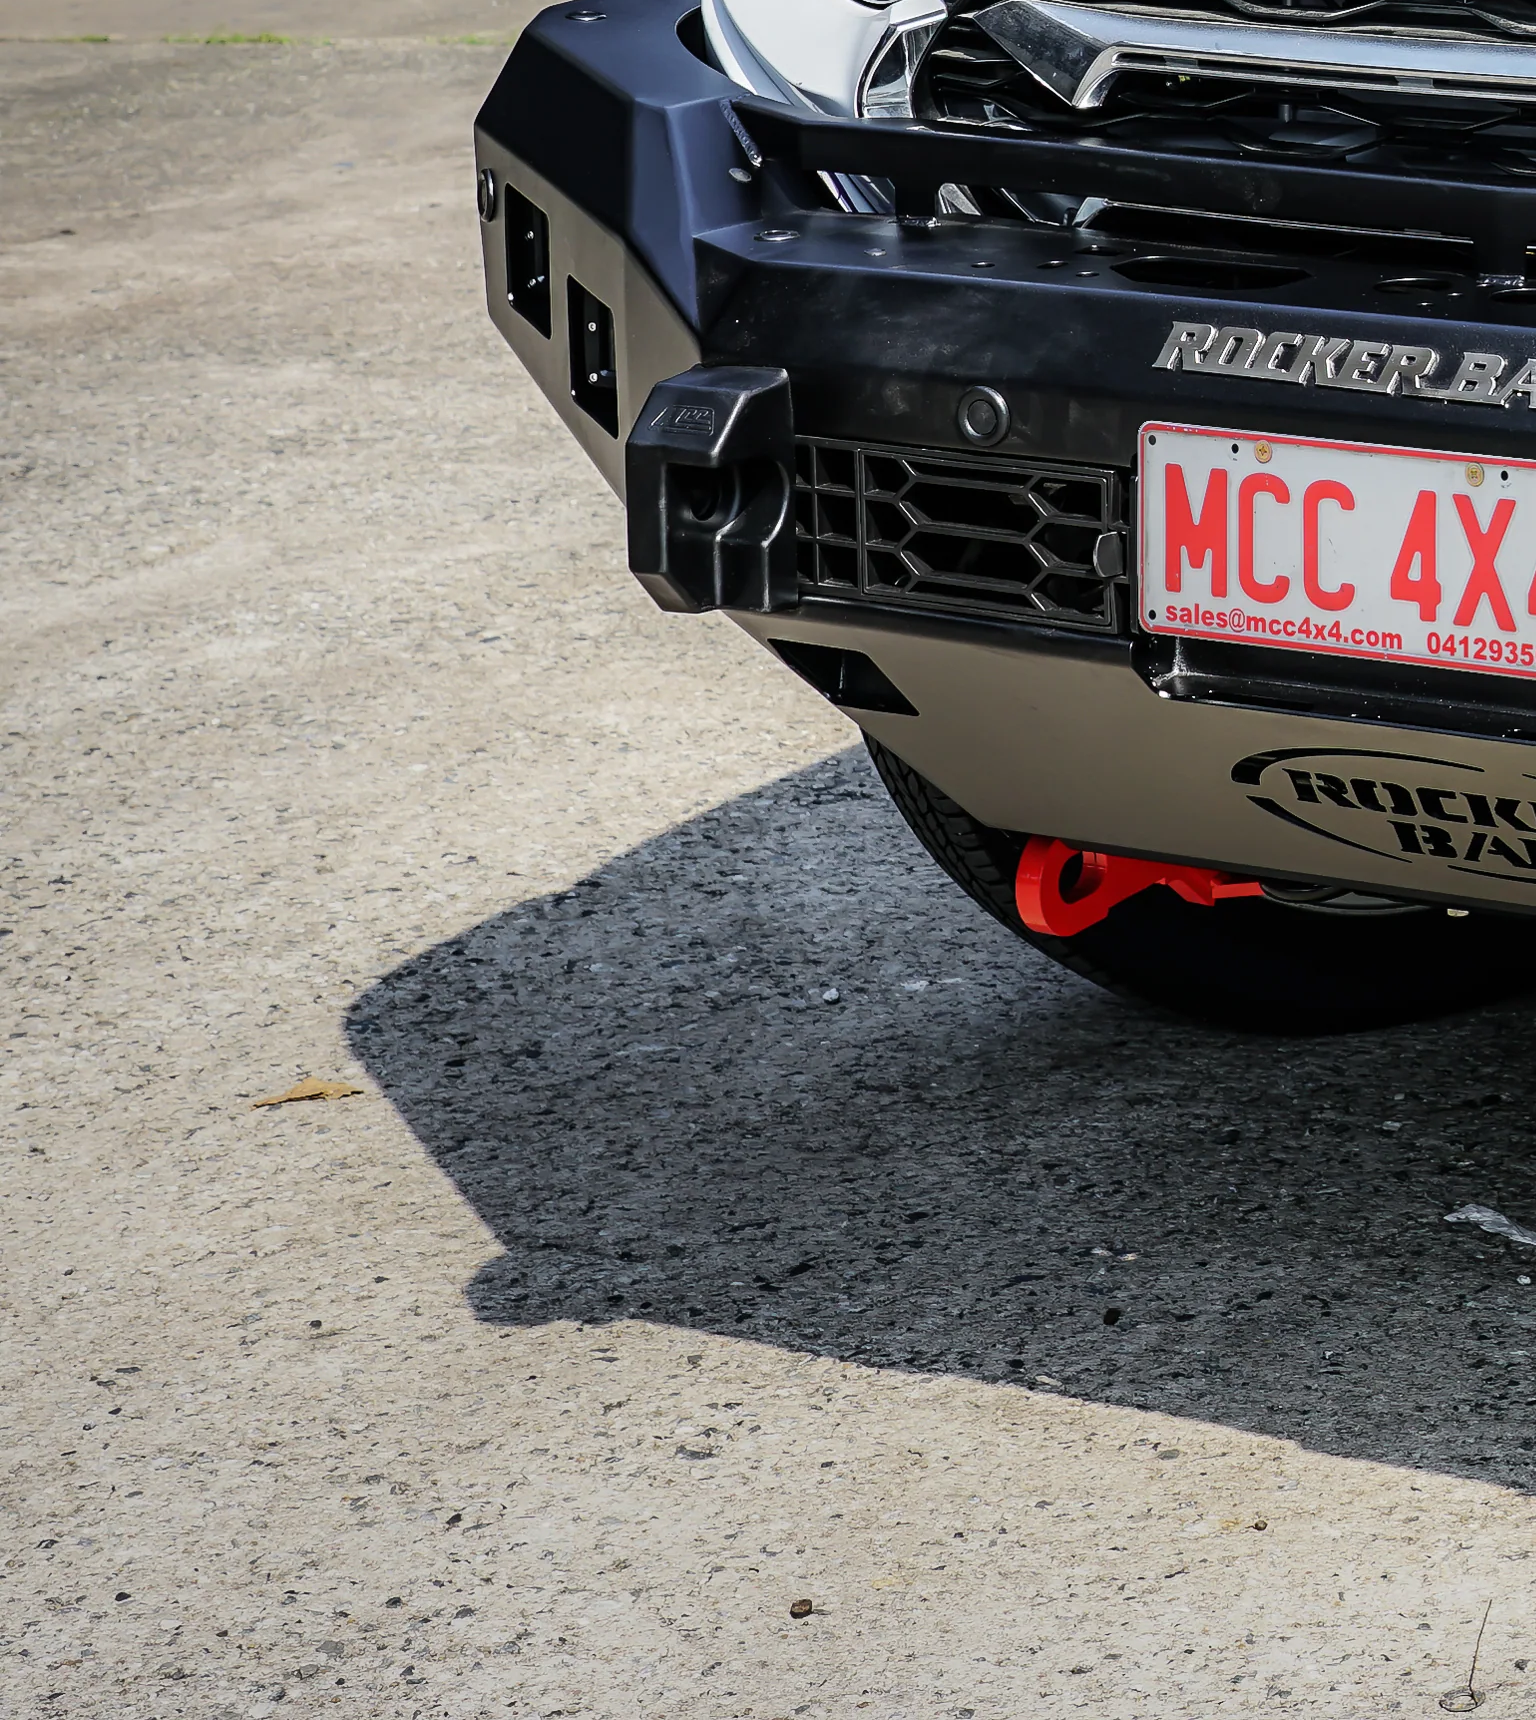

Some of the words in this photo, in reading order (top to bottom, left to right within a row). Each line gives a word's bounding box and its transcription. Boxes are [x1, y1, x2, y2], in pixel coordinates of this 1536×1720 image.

[1151, 320, 1440, 396] ROCKER
[1165, 463, 1356, 613] MCC
[1165, 603, 1402, 651] sales@mcc4x4.com
